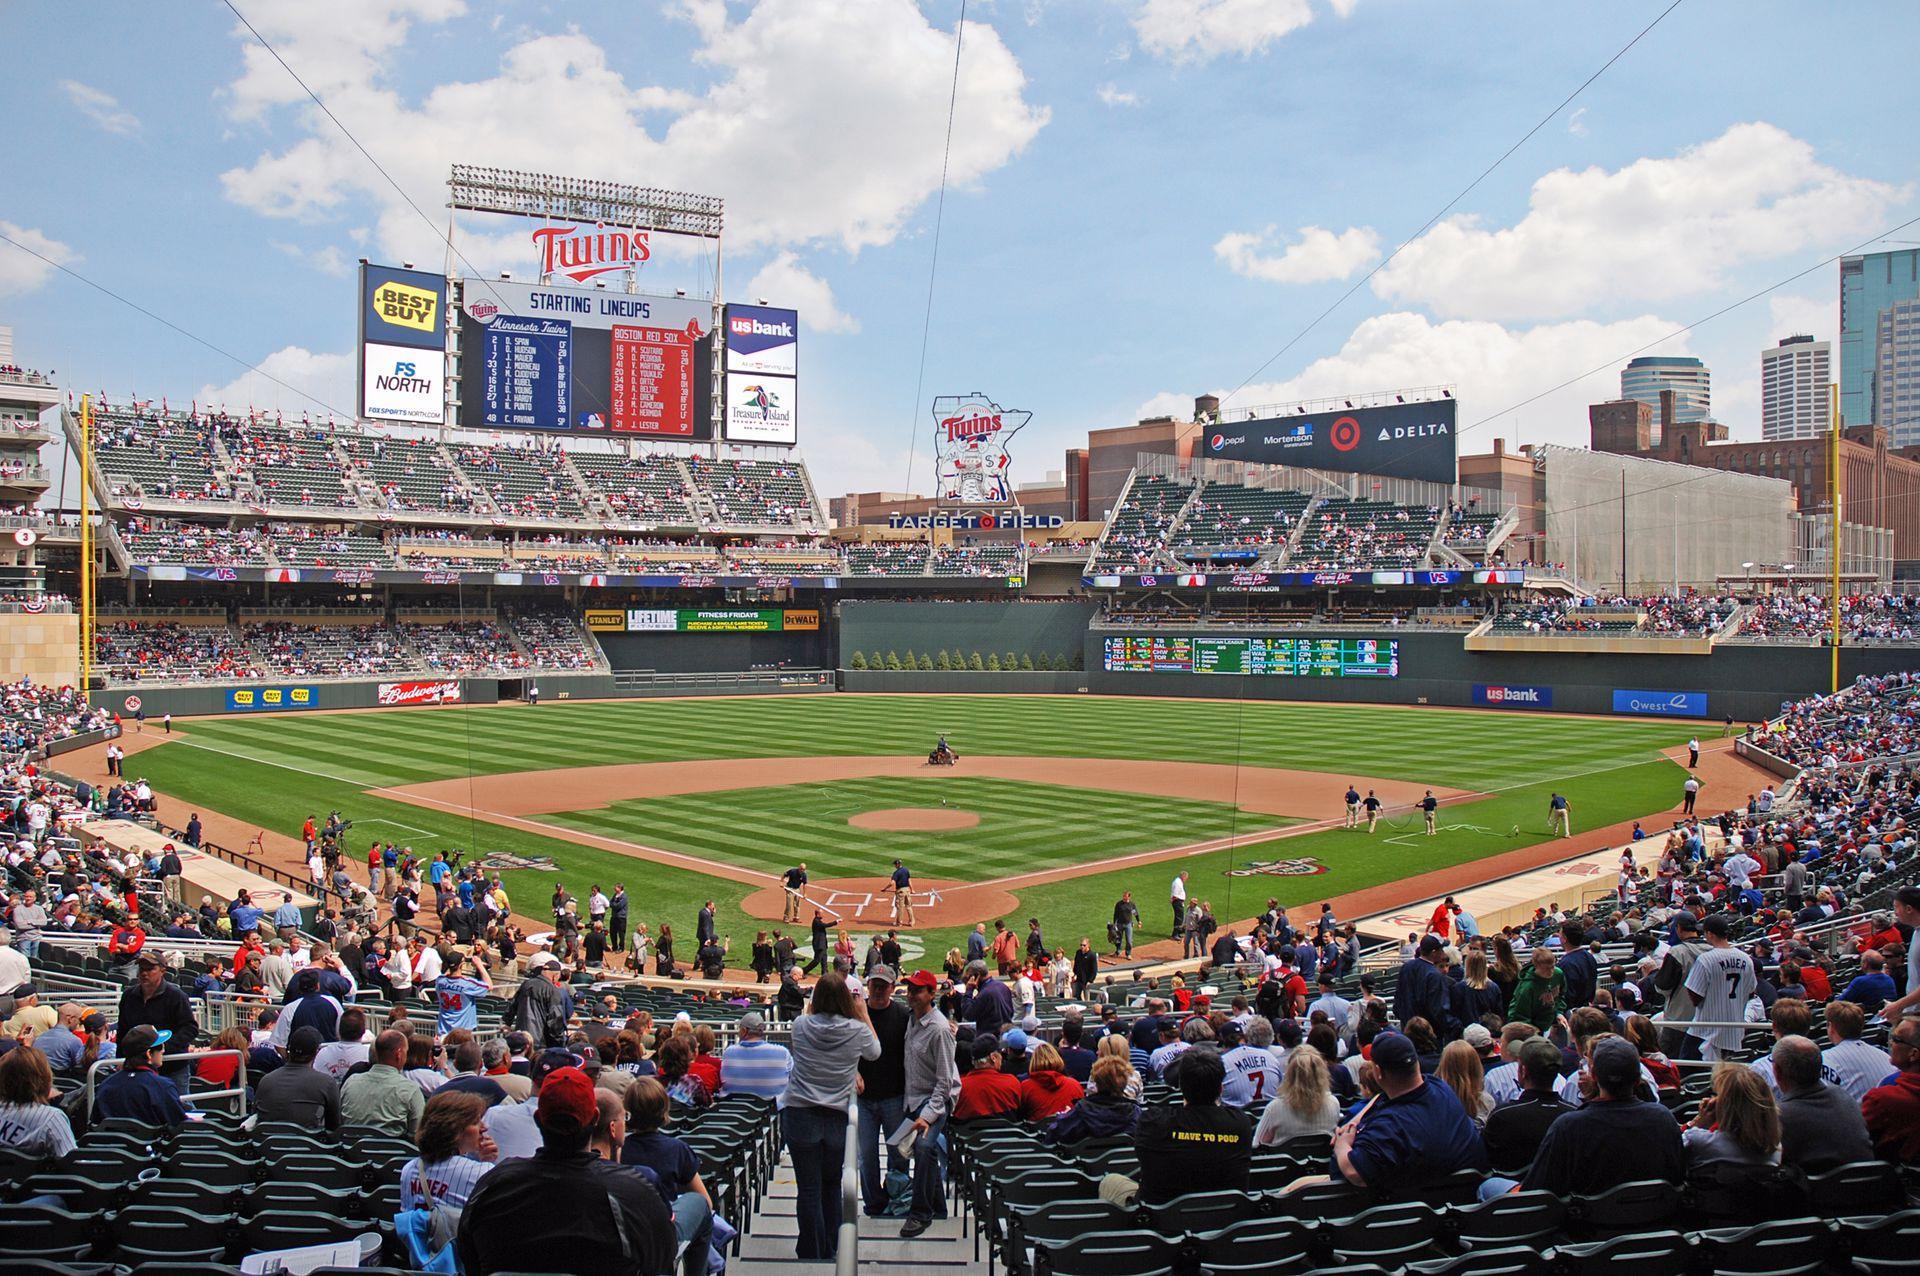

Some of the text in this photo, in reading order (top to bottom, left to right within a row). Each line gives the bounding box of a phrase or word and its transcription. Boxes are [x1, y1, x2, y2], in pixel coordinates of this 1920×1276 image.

[532, 222, 651, 276] Twins
[382, 289, 435, 311] BEST
[530, 292, 650, 318] STARTING LINEUPS
[383, 303, 429, 324] BUY
[469, 302, 498, 318] Twins
[489, 318, 568, 334] Minnesota Twins
[492, 336, 498, 344] 2
[514, 338, 529, 346] SPAN
[614, 328, 678, 343] BOSTON RED SOX
[514, 346, 536, 355] HUDSON
[514, 354, 533, 363] MAUER
[394, 362, 416, 377] FS
[488, 360, 497, 368] 33
[514, 362, 540, 371] MORNEAU
[492, 368, 540, 379] 5 CUDDYER
[614, 368, 623, 376] 20
[376, 375, 431, 394] NORTH
[488, 376, 497, 384] 16
[514, 378, 532, 387] KUBEL
[615, 376, 655, 386] 34 ORTIZ
[488, 384, 496, 392] 21
[514, 386, 533, 395] YOUNG
[614, 384, 623, 392] 29
[487, 393, 497, 401] 27
[513, 394, 532, 402] HARDY
[614, 399, 623, 407] 23
[513, 402, 532, 411] PUNTO
[614, 407, 623, 415] 32
[487, 414, 497, 422] 48
[732, 407, 790, 421] Treasure Island
[616, 420, 623, 428] 31
[639, 421, 659, 429] LESTER
[941, 412, 1002, 442] Twins
[1394, 423, 1448, 438] DELTA
[1225, 435, 1245, 447] pepsi
[1264, 433, 1313, 445] Mortenson
[889, 516, 1063, 529] TARGET FIELD
[23, 533, 29, 541] 3
[589, 616, 621, 624] STANLEY
[385, 681, 456, 704] Budweiser
[1630, 699, 1667, 711] Qwest
[1719, 959, 1747, 971] MAUER
[1726, 973, 1741, 999] 7
[440, 992, 462, 1010] 34
[1234, 1056, 1267, 1073] MAUER
[1247, 1070, 1265, 1099] 7
[1178, 1132, 1201, 1141] HAVE
[1203, 1133, 1216, 1142] TO
[1217, 1134, 1240, 1143] POOP
